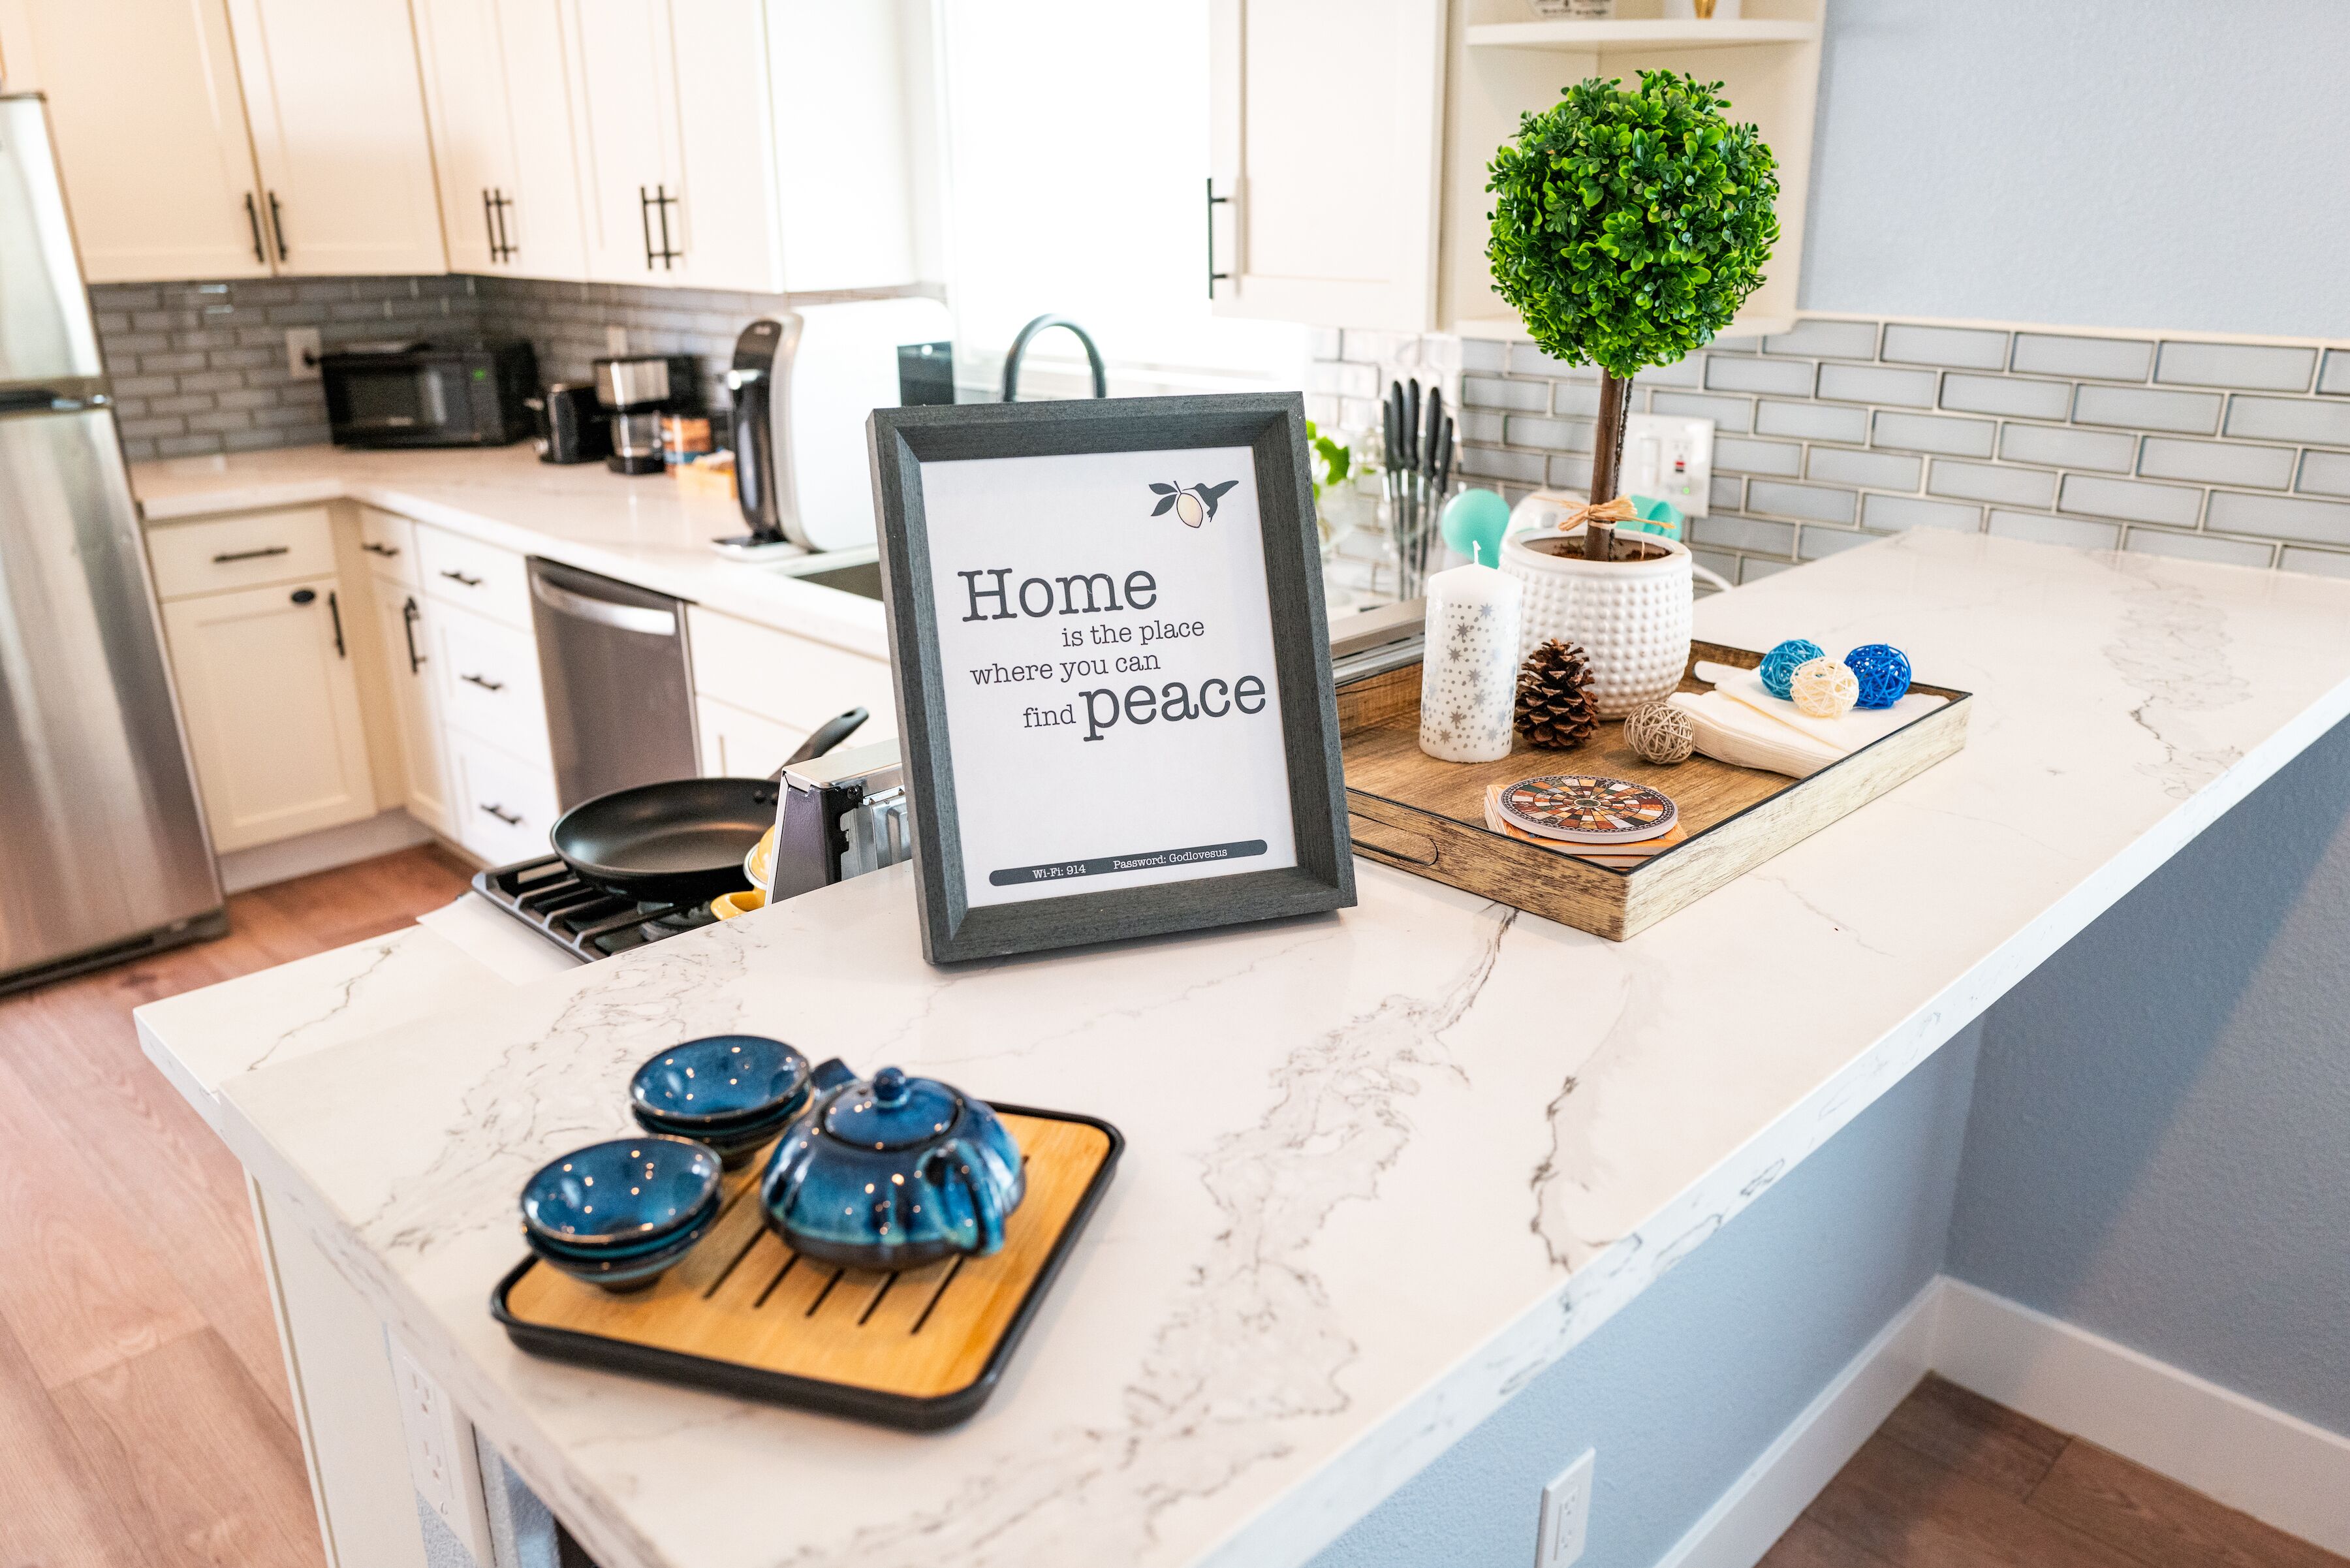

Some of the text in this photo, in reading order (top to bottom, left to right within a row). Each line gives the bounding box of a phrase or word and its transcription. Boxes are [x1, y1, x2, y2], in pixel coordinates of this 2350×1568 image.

[957, 568, 1157, 623] Home
[1061, 619, 1204, 647] is the place
[969, 655, 1161, 685] where you can
[1023, 675, 1266, 742] find peace
[1031, 849, 1228, 879] Wi-Fi: 914 Password: Godlovesus
